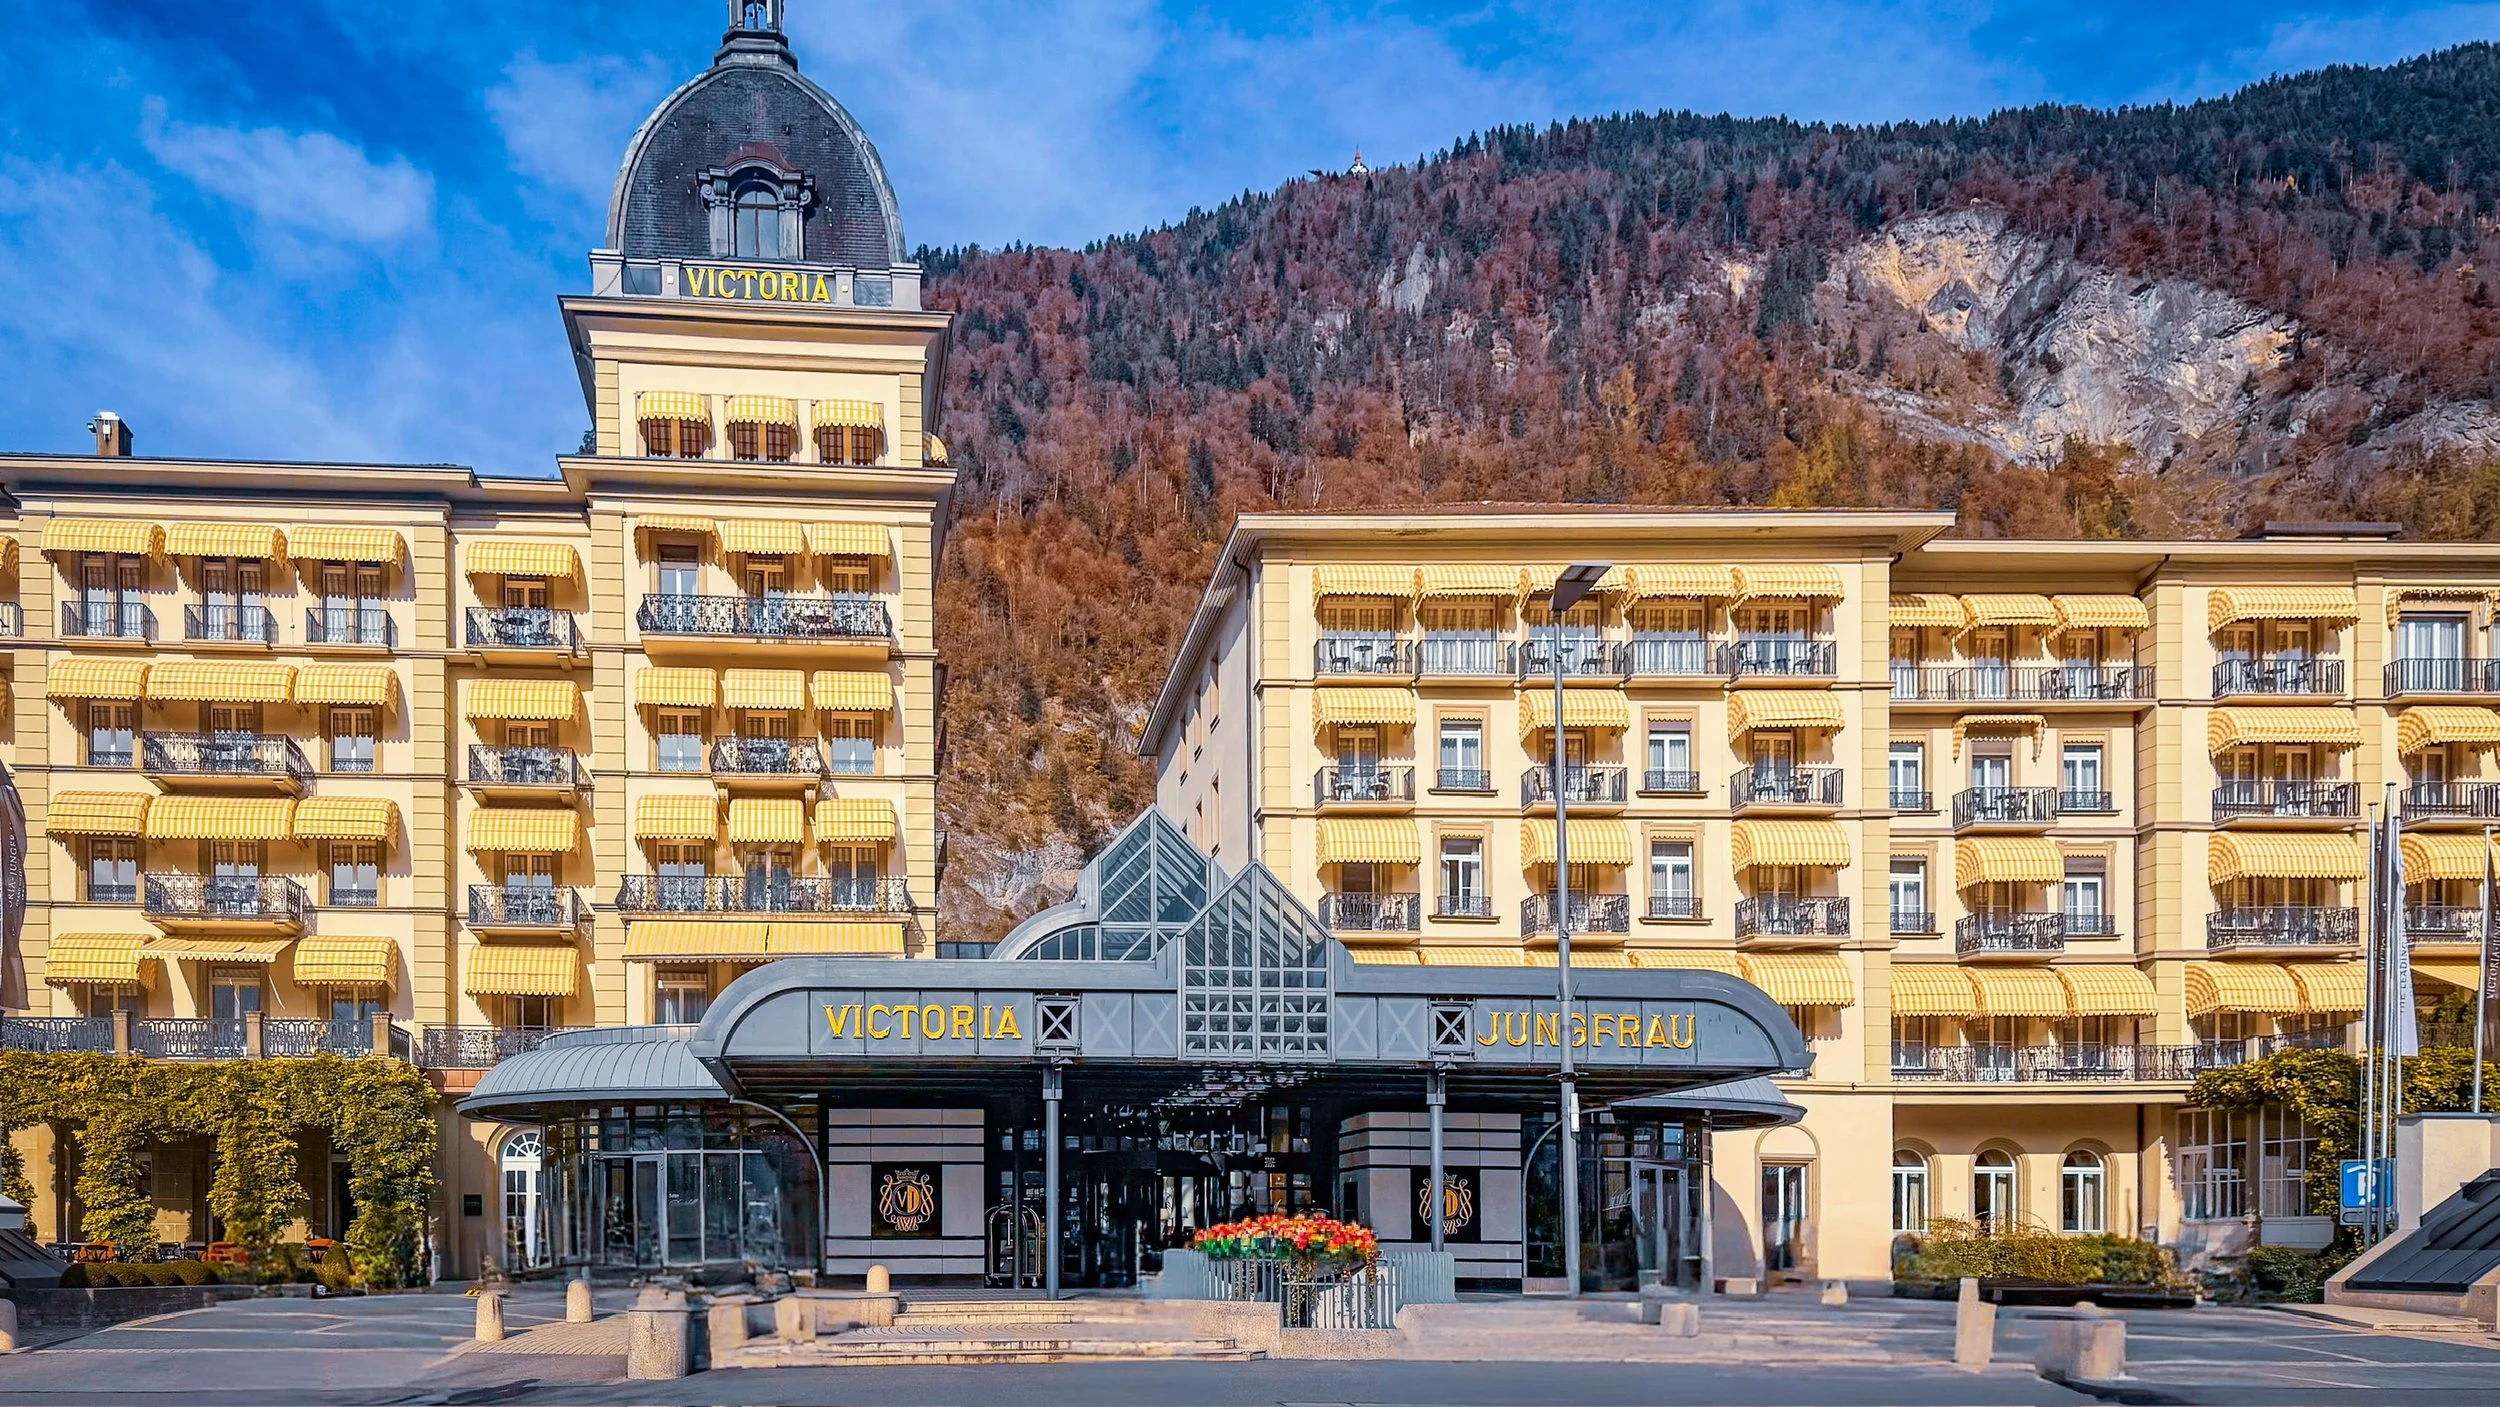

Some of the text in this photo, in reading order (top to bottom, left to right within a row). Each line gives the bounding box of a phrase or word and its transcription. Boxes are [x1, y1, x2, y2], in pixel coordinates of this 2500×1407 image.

[685, 267, 831, 303] VICTORIA
[822, 1003, 1023, 1040] VICTORIA
[1477, 1011, 1696, 1049] JUNGFRAU
